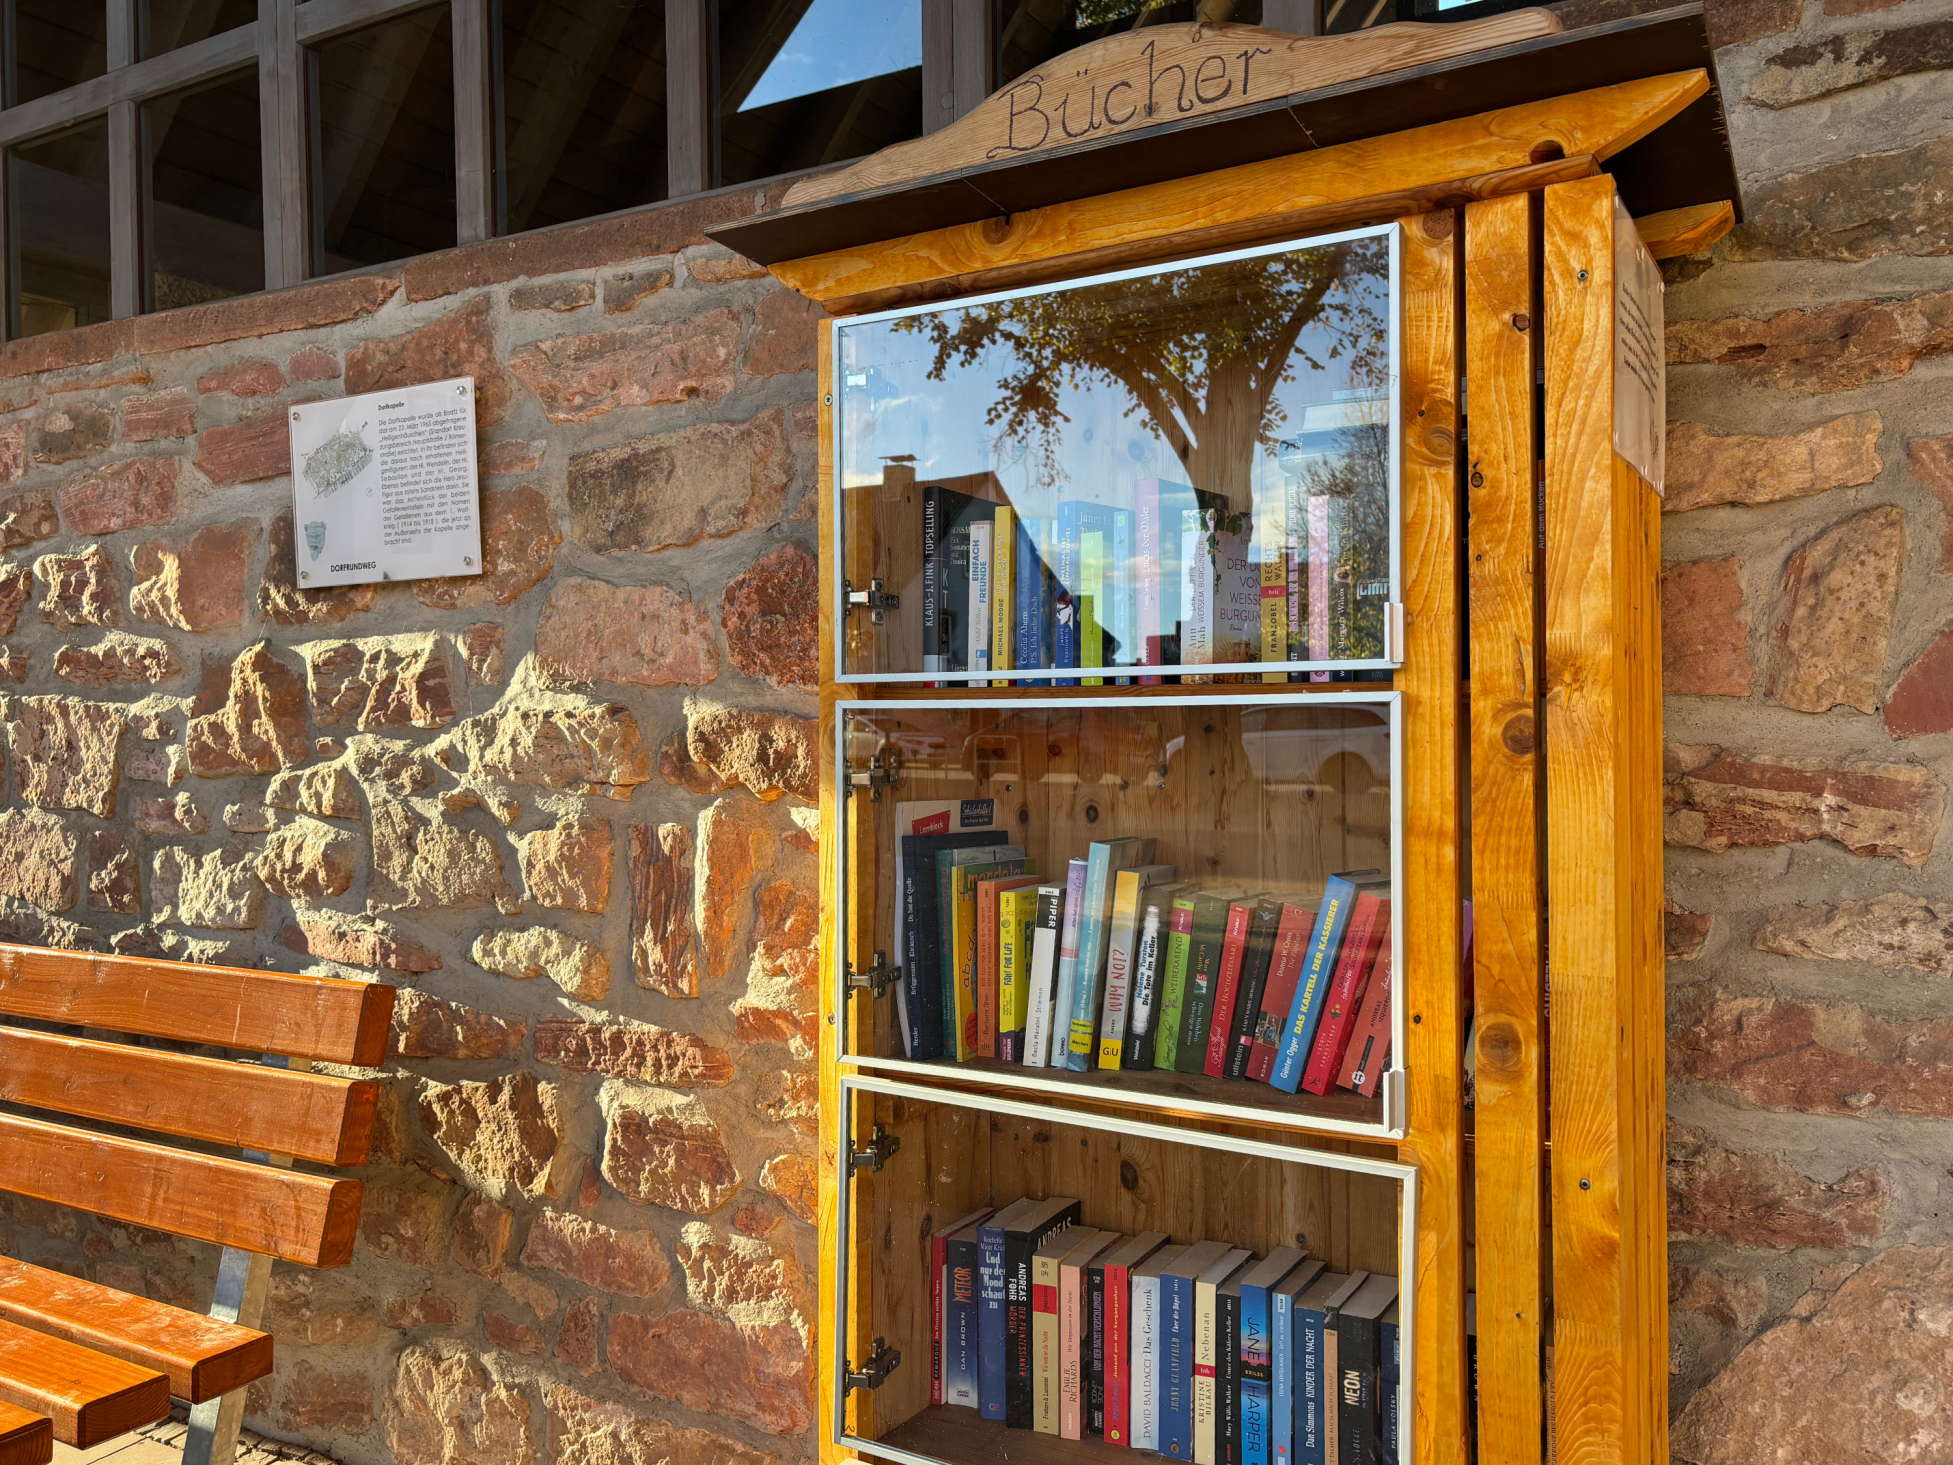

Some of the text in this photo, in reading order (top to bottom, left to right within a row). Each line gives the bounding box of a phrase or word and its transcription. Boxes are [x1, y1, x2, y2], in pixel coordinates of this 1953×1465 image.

[986, 40, 1271, 159] Bücher
[378, 402, 405, 411] Dorfkapelle
[925, 501, 935, 555] TOPSELLING
[1340, 513, 1348, 534] Kind
[330, 561, 376, 572] DORFRUNDWEG
[1141, 550, 1150, 573] Lucas
[1227, 557, 1247, 571] DER
[1274, 540, 1282, 581] WALZER
[925, 562, 934, 626] KLAUS-J. FINK
[979, 561, 987, 603] FREUNDE
[1020, 612, 1028, 664] Cecelia Ahern
[1197, 626, 1206, 649] Mah
[1337, 588, 1346, 649] Margaret Wilcox
[920, 820, 944, 835] Lernblock
[1048, 899, 1058, 927] PIPER
[1232, 916, 1240, 936] Knaur.
[1004, 942, 1012, 969] FOR LIFE
[1136, 940, 1148, 998] Helene Tursten
[1142, 936, 1156, 1006] Die Tote im Keller
[1170, 936, 1183, 994] WEIBERABEND
[1277, 956, 1287, 977] Donna
[1283, 931, 1292, 948] Cross
[1293, 898, 1340, 1035] DAS KARTELL DER KASSIERER
[1108, 949, 1128, 1012] WHY NOT?
[1219, 944, 1237, 1020] DER HOCHZEITSSARI
[1369, 1000, 1382, 1027] ANDREAS
[1378, 991, 1391, 1023] IZQUIERDO
[1232, 1045, 1244, 1076] ullstein
[1261, 1056, 1269, 1077] ROMAN
[1280, 1037, 1299, 1078] Günter Ogger
[980, 1267, 993, 1275] nur
[985, 1252, 1000, 1264] Und
[954, 1267, 972, 1303] METEOR
[983, 1275, 1003, 1288] Mond
[1018, 1263, 1026, 1301] ANDREAS
[989, 1301, 998, 1309] zu
[1018, 1306, 1026, 1376] DER PRINZESSINNEN
[1201, 1312, 1210, 1360] Nebenan
[1247, 1317, 1260, 1360] JANE
[1069, 1360, 1078, 1403] RICHARDS
[1142, 1289, 1152, 1438] DAVID BALDACCI Das Geschenk
[1171, 1337, 1179, 1412] JENNY GLANFIELD
[1305, 1328, 1315, 1448] Dan Simmons KINDER DER NACHT
[1344, 1370, 1361, 1405] NEON
[1247, 1386, 1260, 1452] HARPER
